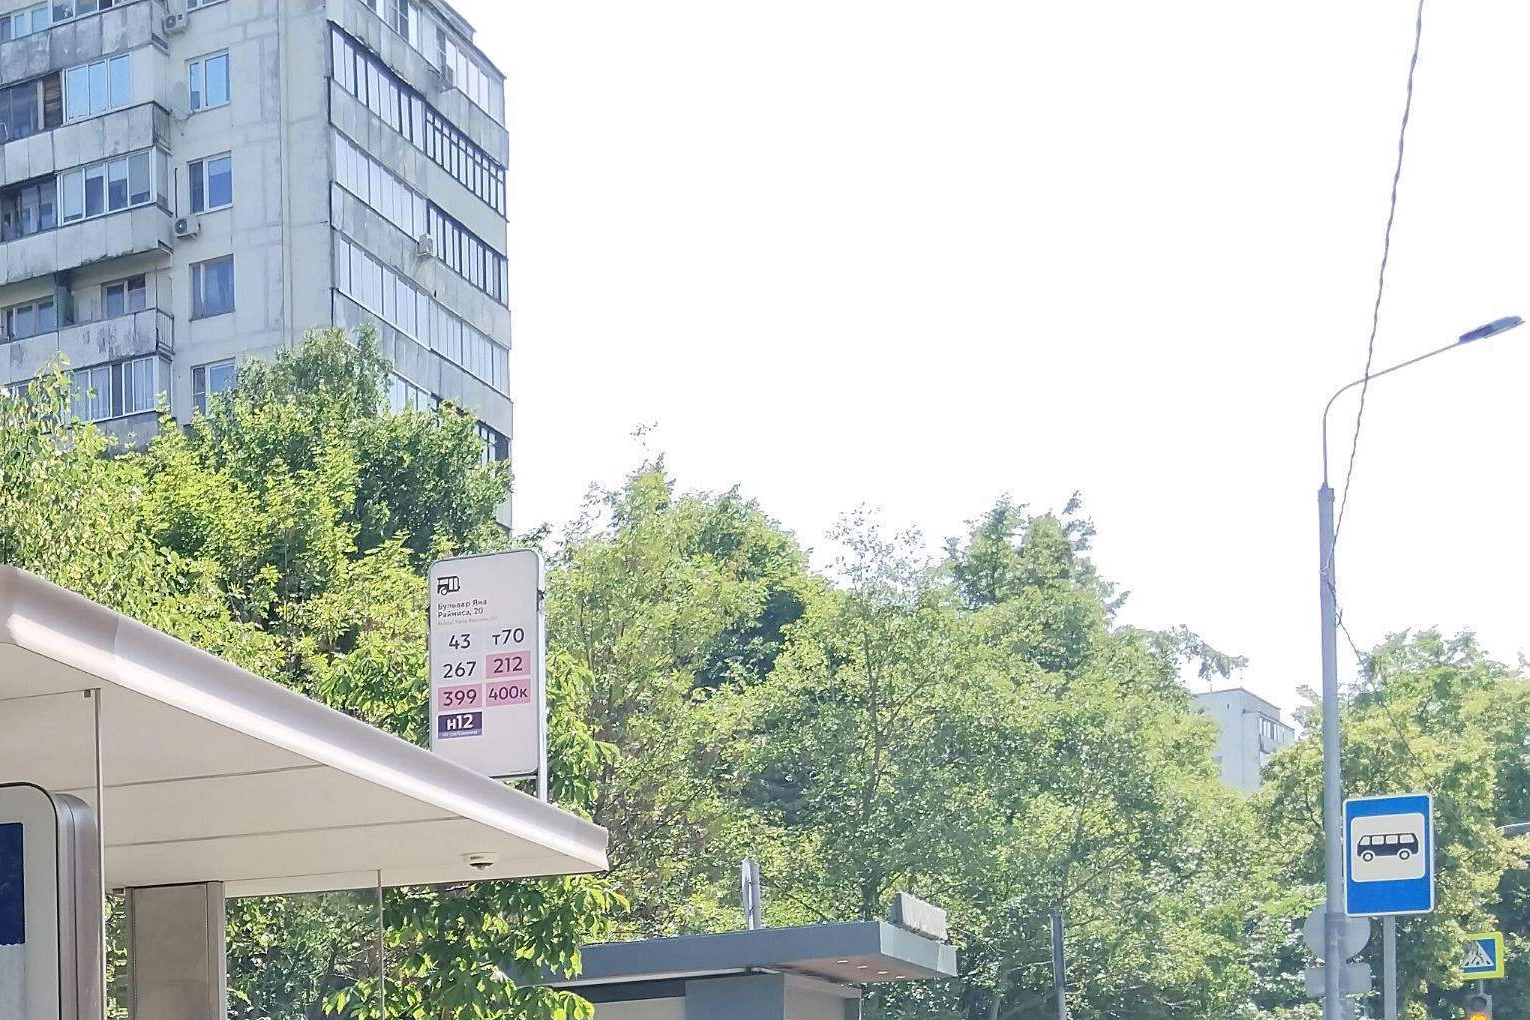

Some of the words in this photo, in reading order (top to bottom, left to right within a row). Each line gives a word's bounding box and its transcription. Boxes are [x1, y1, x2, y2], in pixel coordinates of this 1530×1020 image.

[448, 633, 471, 650] 43
[492, 627, 525, 646] т70
[443, 661, 477, 679] 267
[493, 656, 523, 674] 212
[443, 689, 477, 707] 399
[488, 684, 528, 701] 400к
